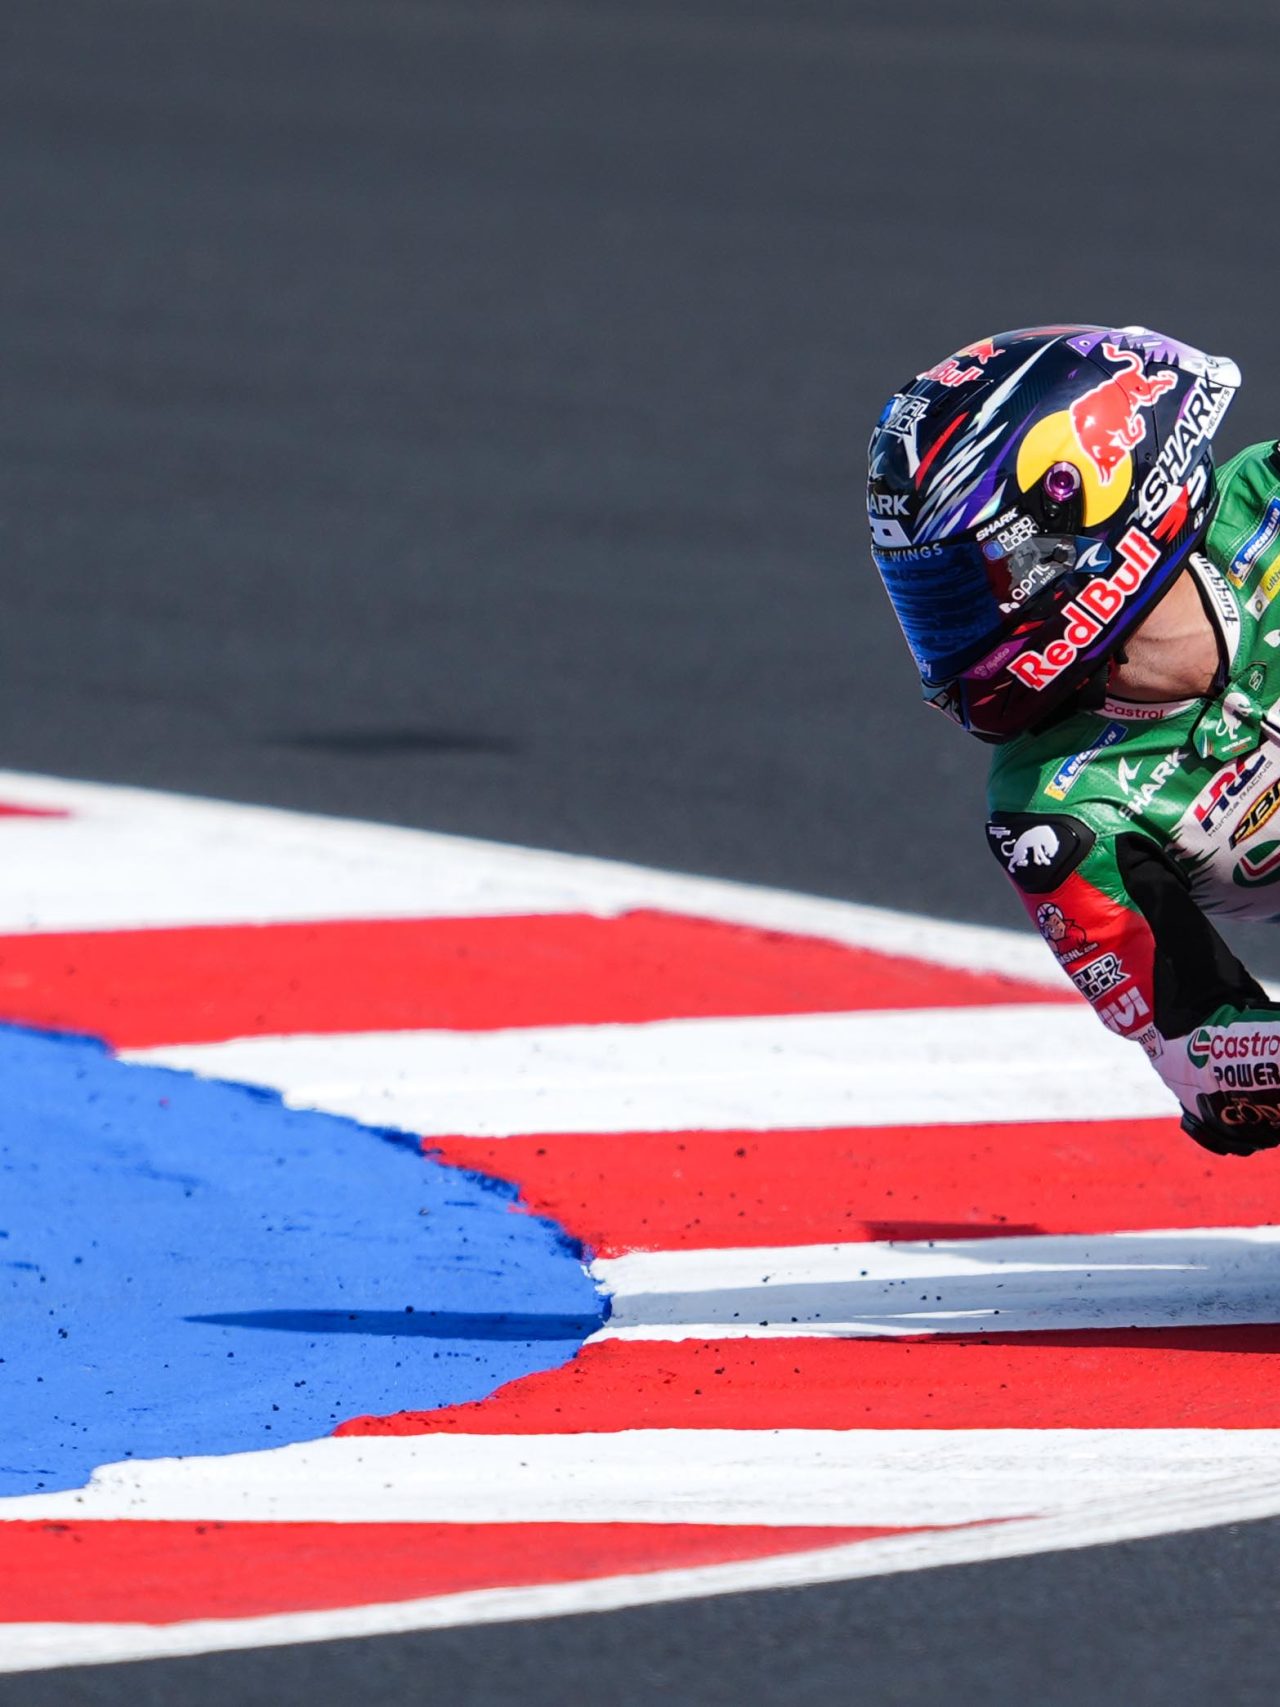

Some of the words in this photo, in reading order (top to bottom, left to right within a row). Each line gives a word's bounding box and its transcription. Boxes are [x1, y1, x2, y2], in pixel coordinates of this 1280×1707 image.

[1140, 366, 1226, 528] SHARK
[869, 494, 911, 516] ARK
[975, 507, 1019, 542] SHARK
[997, 515, 1034, 543] QUAD
[1002, 523, 1039, 552] LOCK
[892, 543, 944, 563] WINGS
[1040, 569, 1057, 586] Moto
[1006, 601, 1104, 692] Red
[1075, 525, 1162, 625] Bull
[1102, 702, 1165, 720] Castrol
